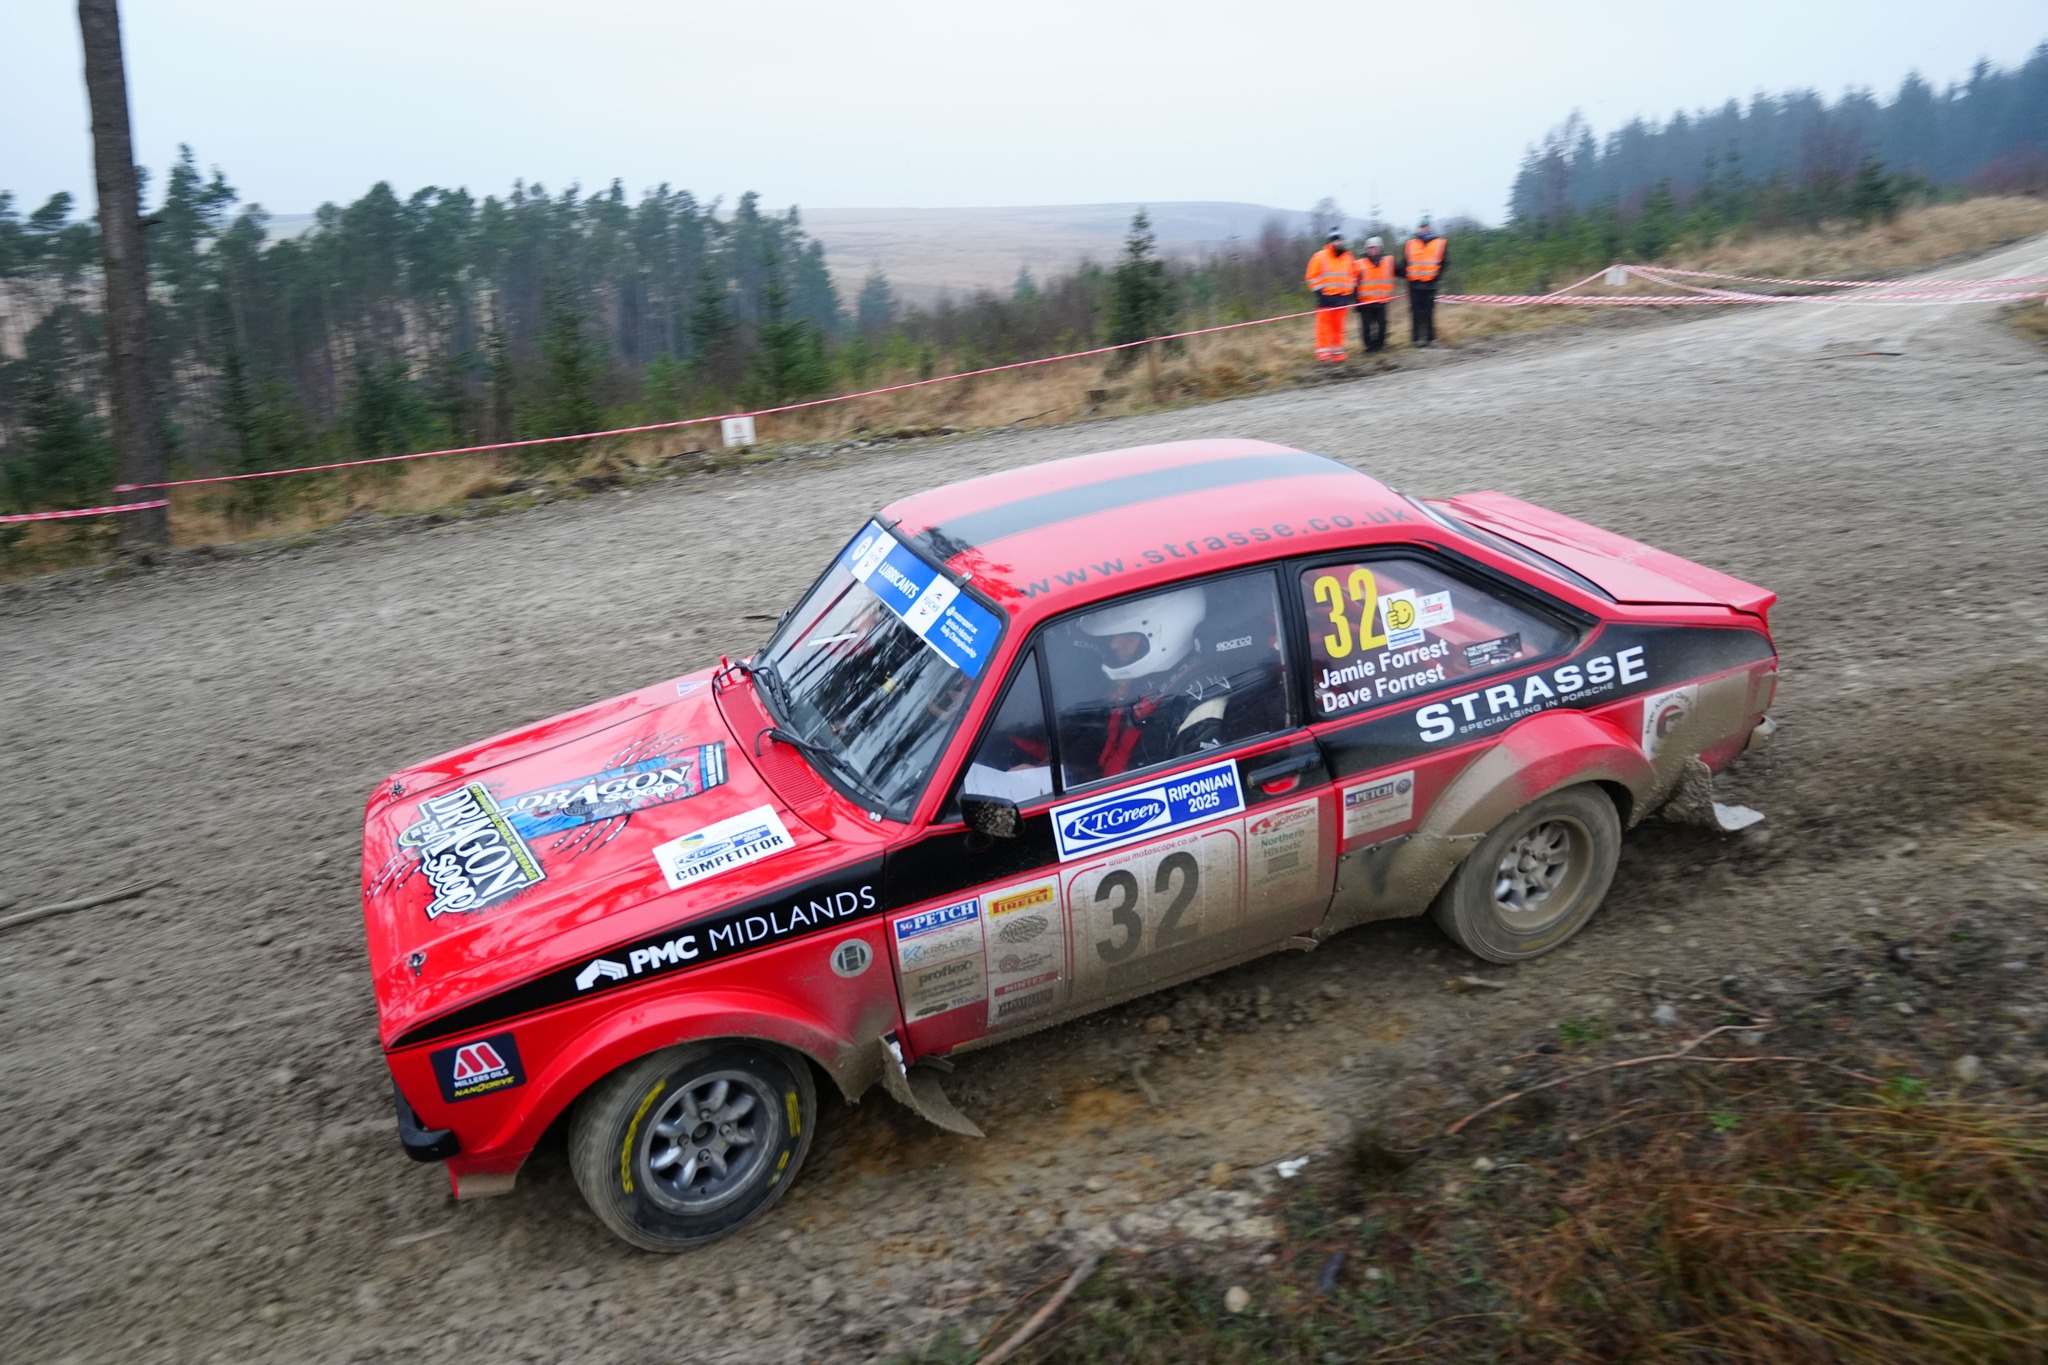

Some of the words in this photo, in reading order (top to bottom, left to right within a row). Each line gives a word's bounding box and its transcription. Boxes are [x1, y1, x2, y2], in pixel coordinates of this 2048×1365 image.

[1024, 506, 1414, 599] www.strasse.co.uk
[877, 561, 920, 600] LUBRICANTS
[1313, 568, 1387, 658] 32
[1215, 635, 1252, 651] sparco
[1318, 659, 1375, 689] Jamie
[1378, 638, 1449, 671] Forrest
[1322, 684, 1372, 712] Dave
[1375, 663, 1446, 697] Forrest
[1415, 645, 1648, 743] STRASSE
[1459, 703, 1542, 734] SPECIALISING
[1545, 698, 1558, 708] IN
[1560, 682, 1614, 704] PORSCHE
[516, 765, 693, 810] DRAGON
[1072, 801, 1161, 837] K.T.Green
[1168, 772, 1233, 803] RIPONIAN
[1188, 792, 1220, 813] 2025
[1355, 783, 1393, 803] PETCH
[429, 788, 527, 897] DRAGON
[508, 841, 539, 881] BEVERAGE
[675, 836, 783, 881] COMPETITOR
[1108, 835, 1199, 866] www.motoscope.co.uk
[1261, 829, 1305, 848] Northern
[1264, 840, 1302, 858] Historic
[428, 855, 476, 913] SOOP
[992, 888, 1049, 914] PIRELLI
[629, 935, 699, 974] PMC
[708, 885, 876, 951] MIDLANDS
[899, 921, 913, 931] SG
[913, 902, 975, 930] PETCH
[1094, 851, 1199, 963] 32
[454, 1074, 490, 1088] MILLERS
[490, 1068, 509, 1079] OILS
[454, 1075, 515, 1097] NANODRIVE
